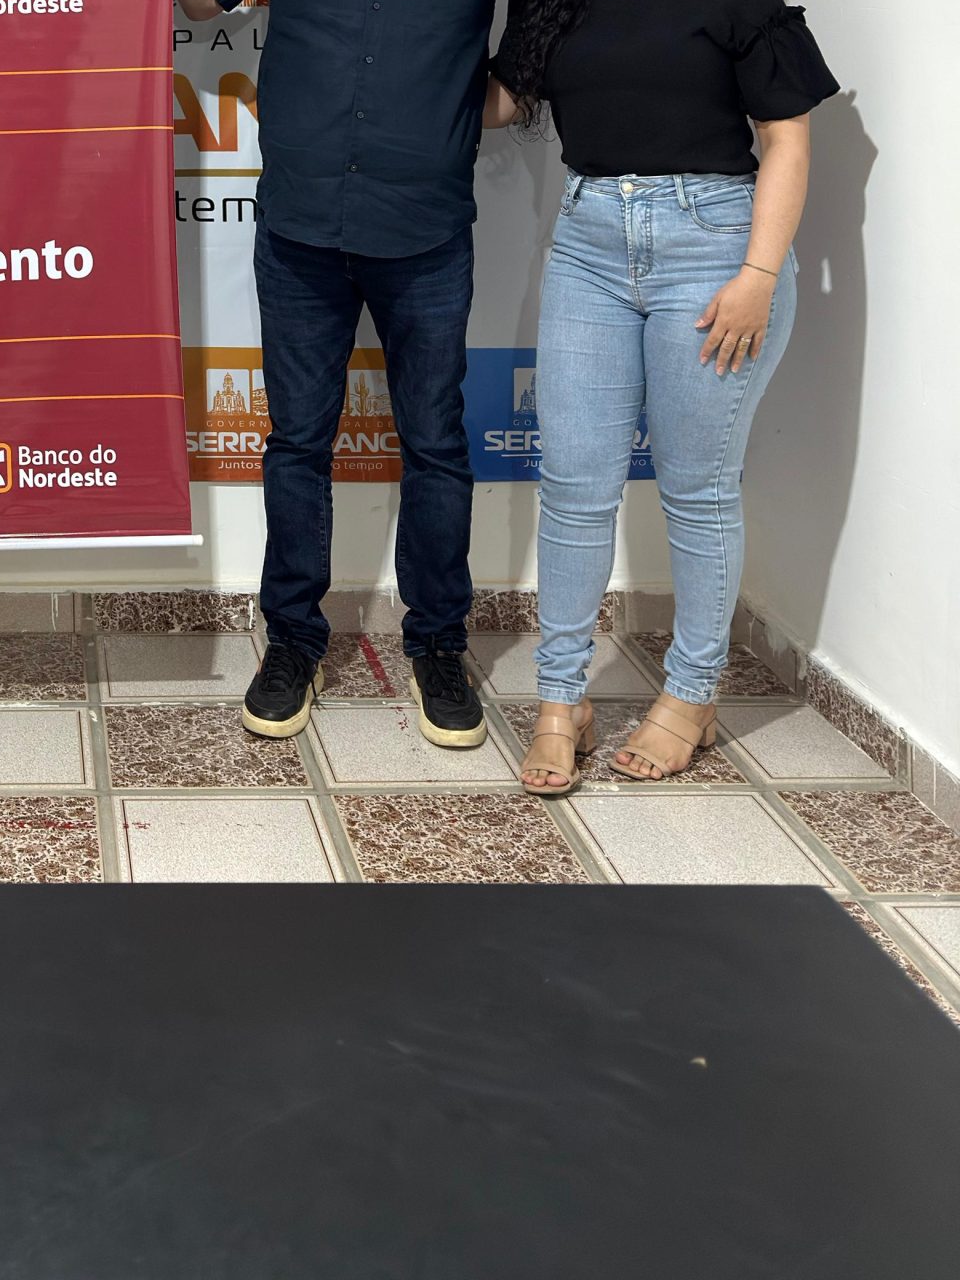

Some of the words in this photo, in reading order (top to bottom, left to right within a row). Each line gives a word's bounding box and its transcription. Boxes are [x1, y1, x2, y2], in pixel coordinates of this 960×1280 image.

[18, 445, 82, 465] Banco
[88, 443, 117, 463] do
[218, 461, 261, 470] Juntos
[344, 460, 383, 470] tempo
[18, 467, 117, 488] Nordeste
